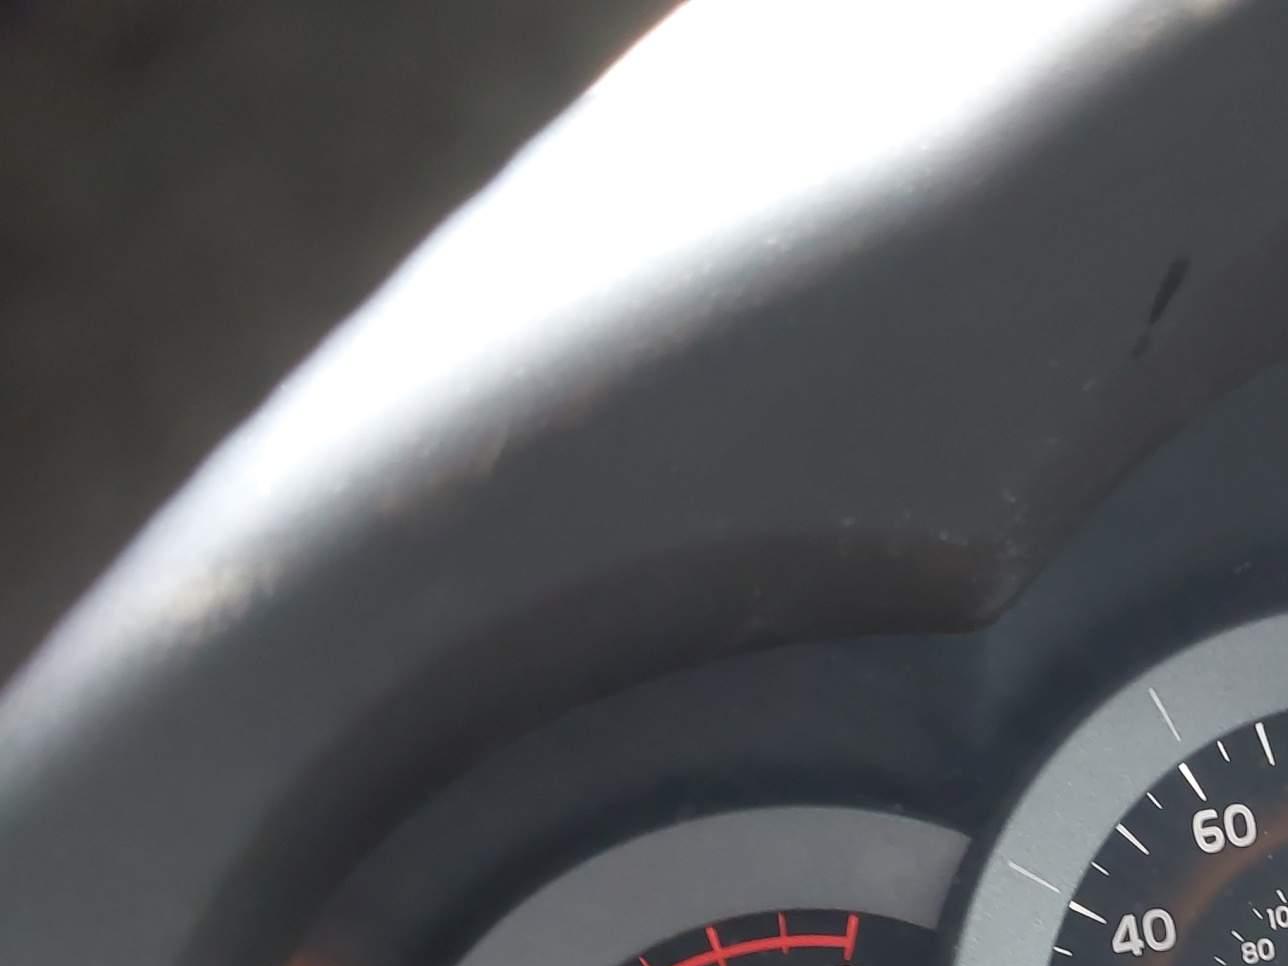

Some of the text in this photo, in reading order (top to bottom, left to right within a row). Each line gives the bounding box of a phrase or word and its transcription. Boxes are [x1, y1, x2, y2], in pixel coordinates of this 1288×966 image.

[1192, 803, 1257, 853] 60
[1112, 908, 1177, 956] 40
[1241, 938, 1276, 965] 80
